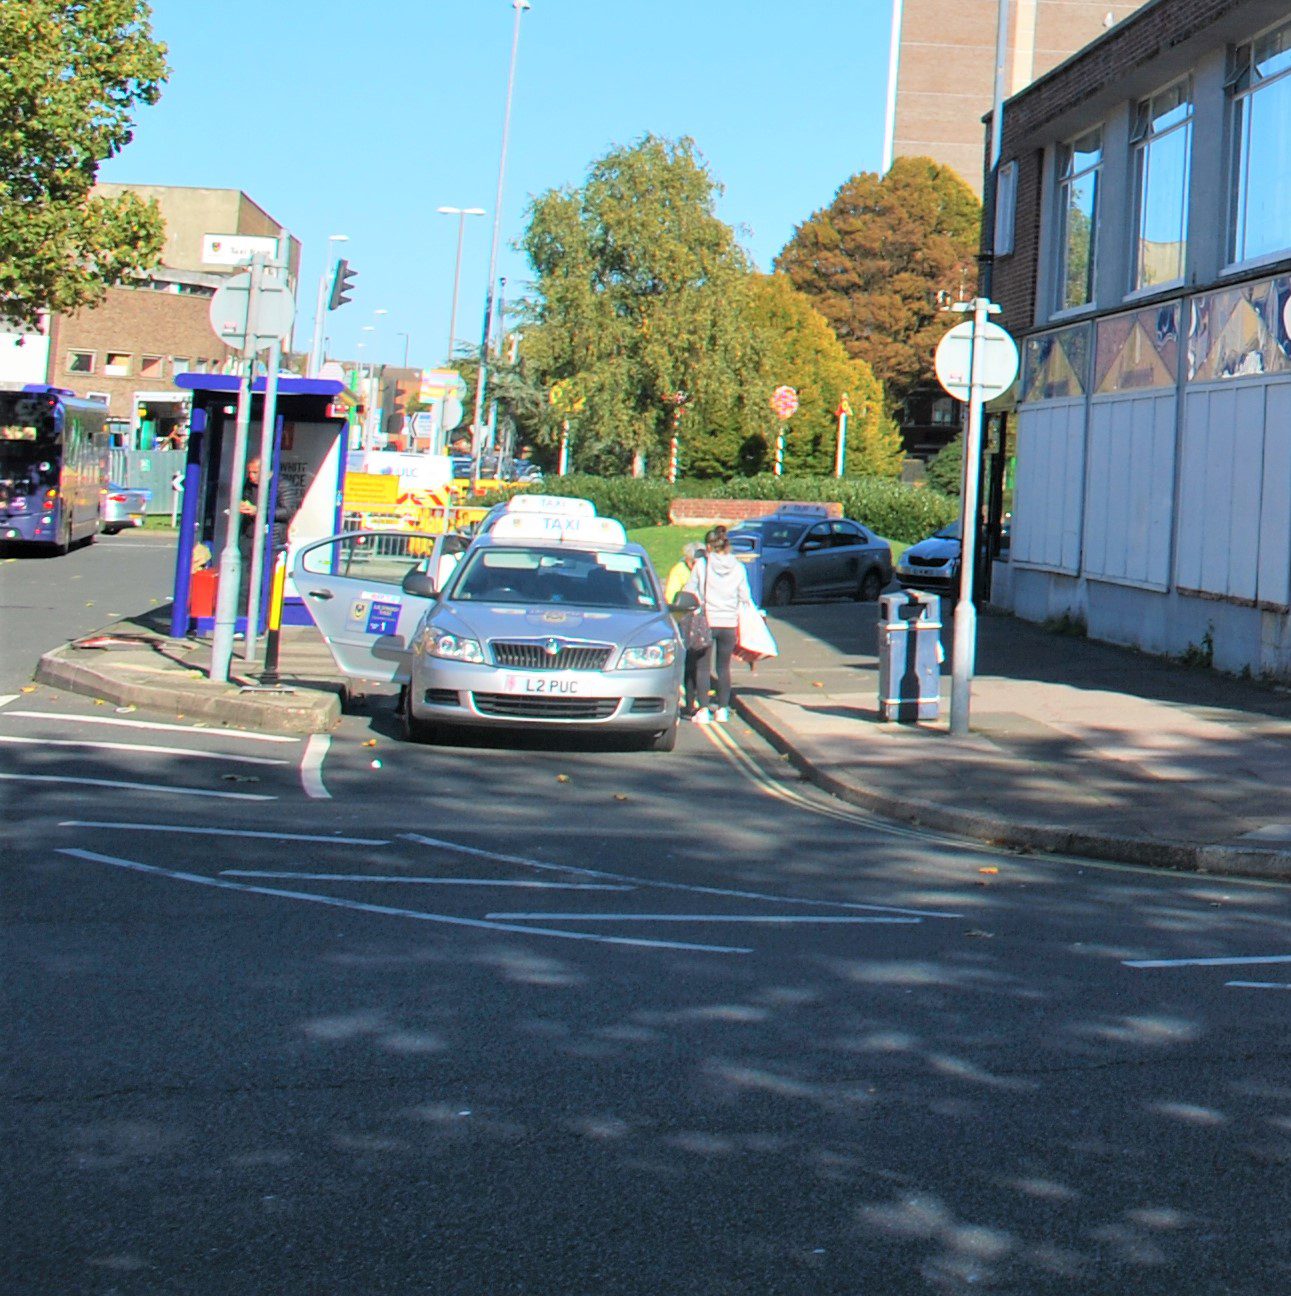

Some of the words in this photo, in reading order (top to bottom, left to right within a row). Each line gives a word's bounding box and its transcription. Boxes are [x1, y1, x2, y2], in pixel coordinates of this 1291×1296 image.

[542, 498, 566, 507] TAXI
[543, 517, 580, 530] TAXI
[526, 678, 545, 692] L2
[549, 680, 579, 694] PUC
